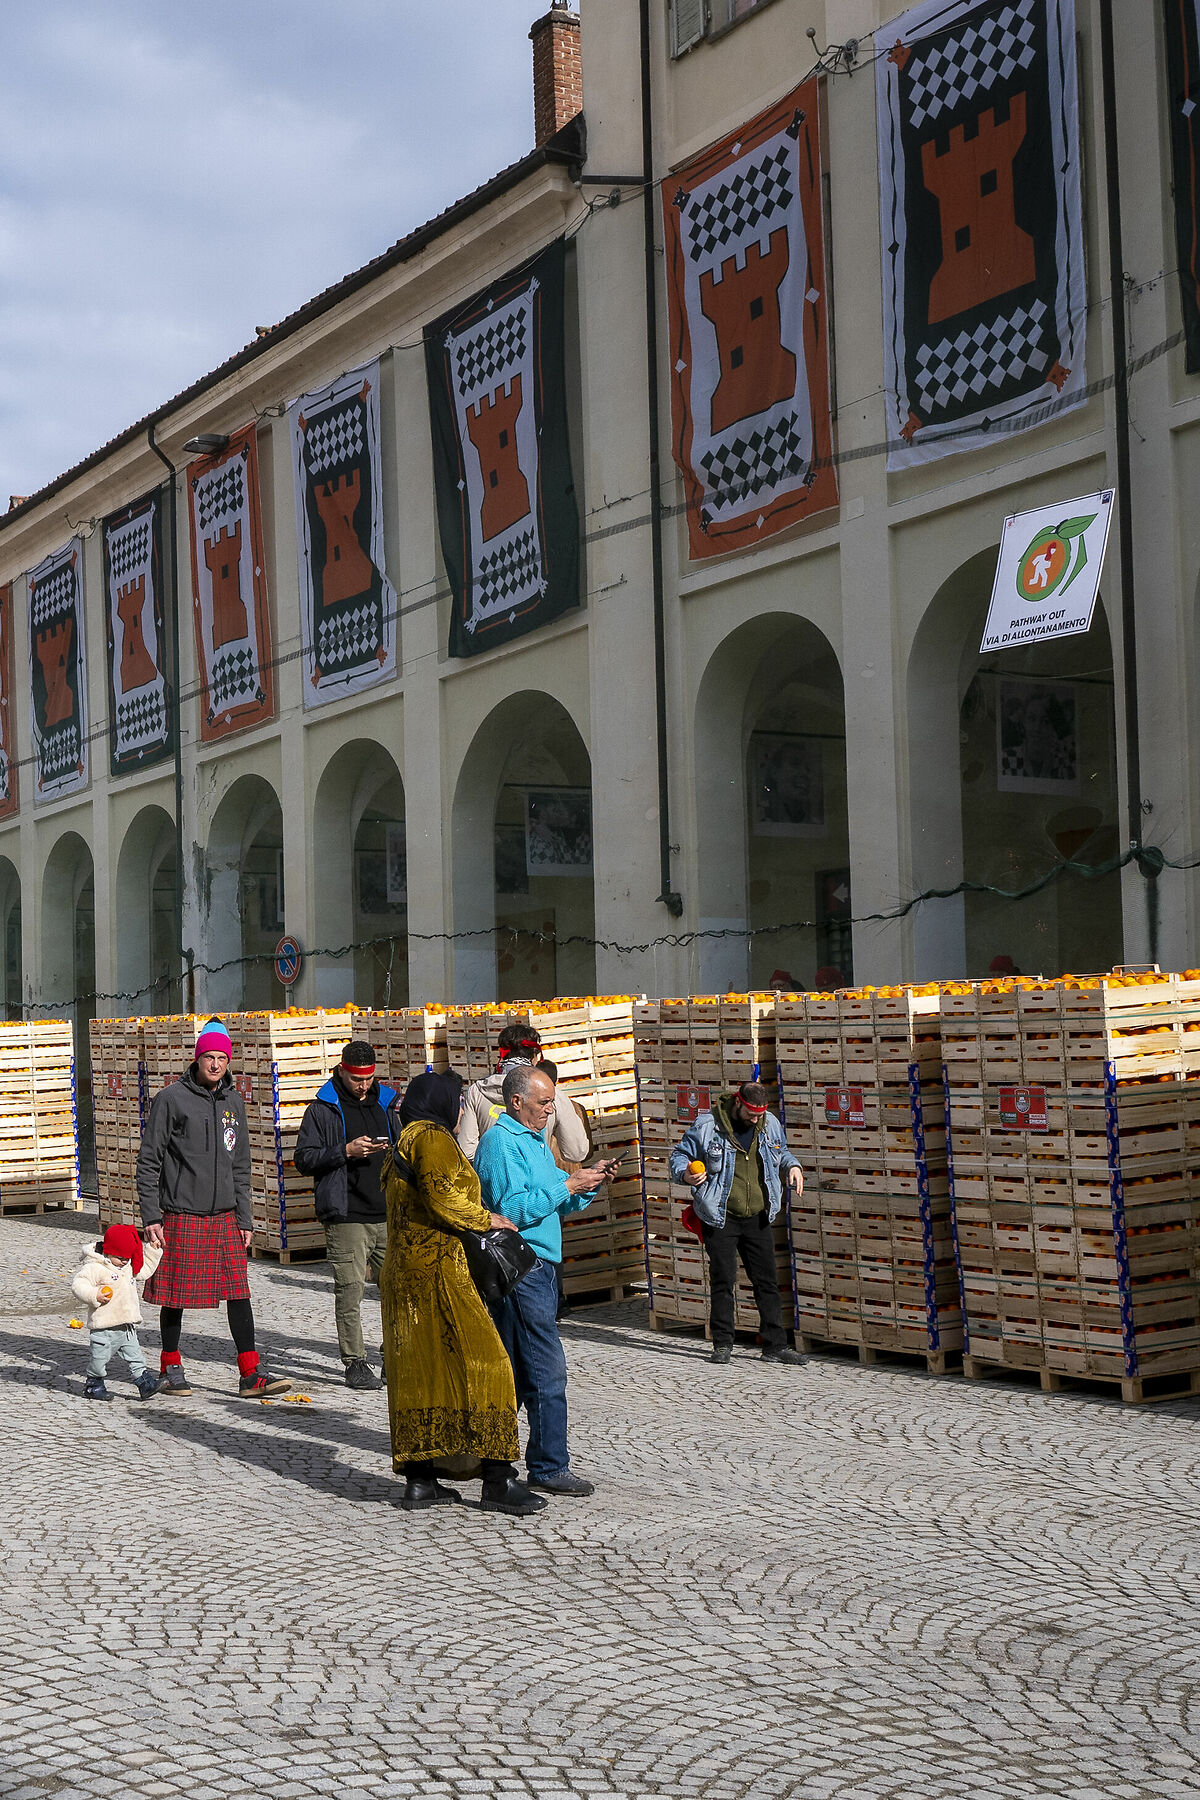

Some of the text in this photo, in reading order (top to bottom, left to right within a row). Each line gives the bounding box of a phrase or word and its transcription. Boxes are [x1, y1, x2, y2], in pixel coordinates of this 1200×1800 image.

[1009, 609, 1066, 629] PATHWAY OUT
[986, 617, 1087, 646] VIA DI ALLONTANAMENTO
